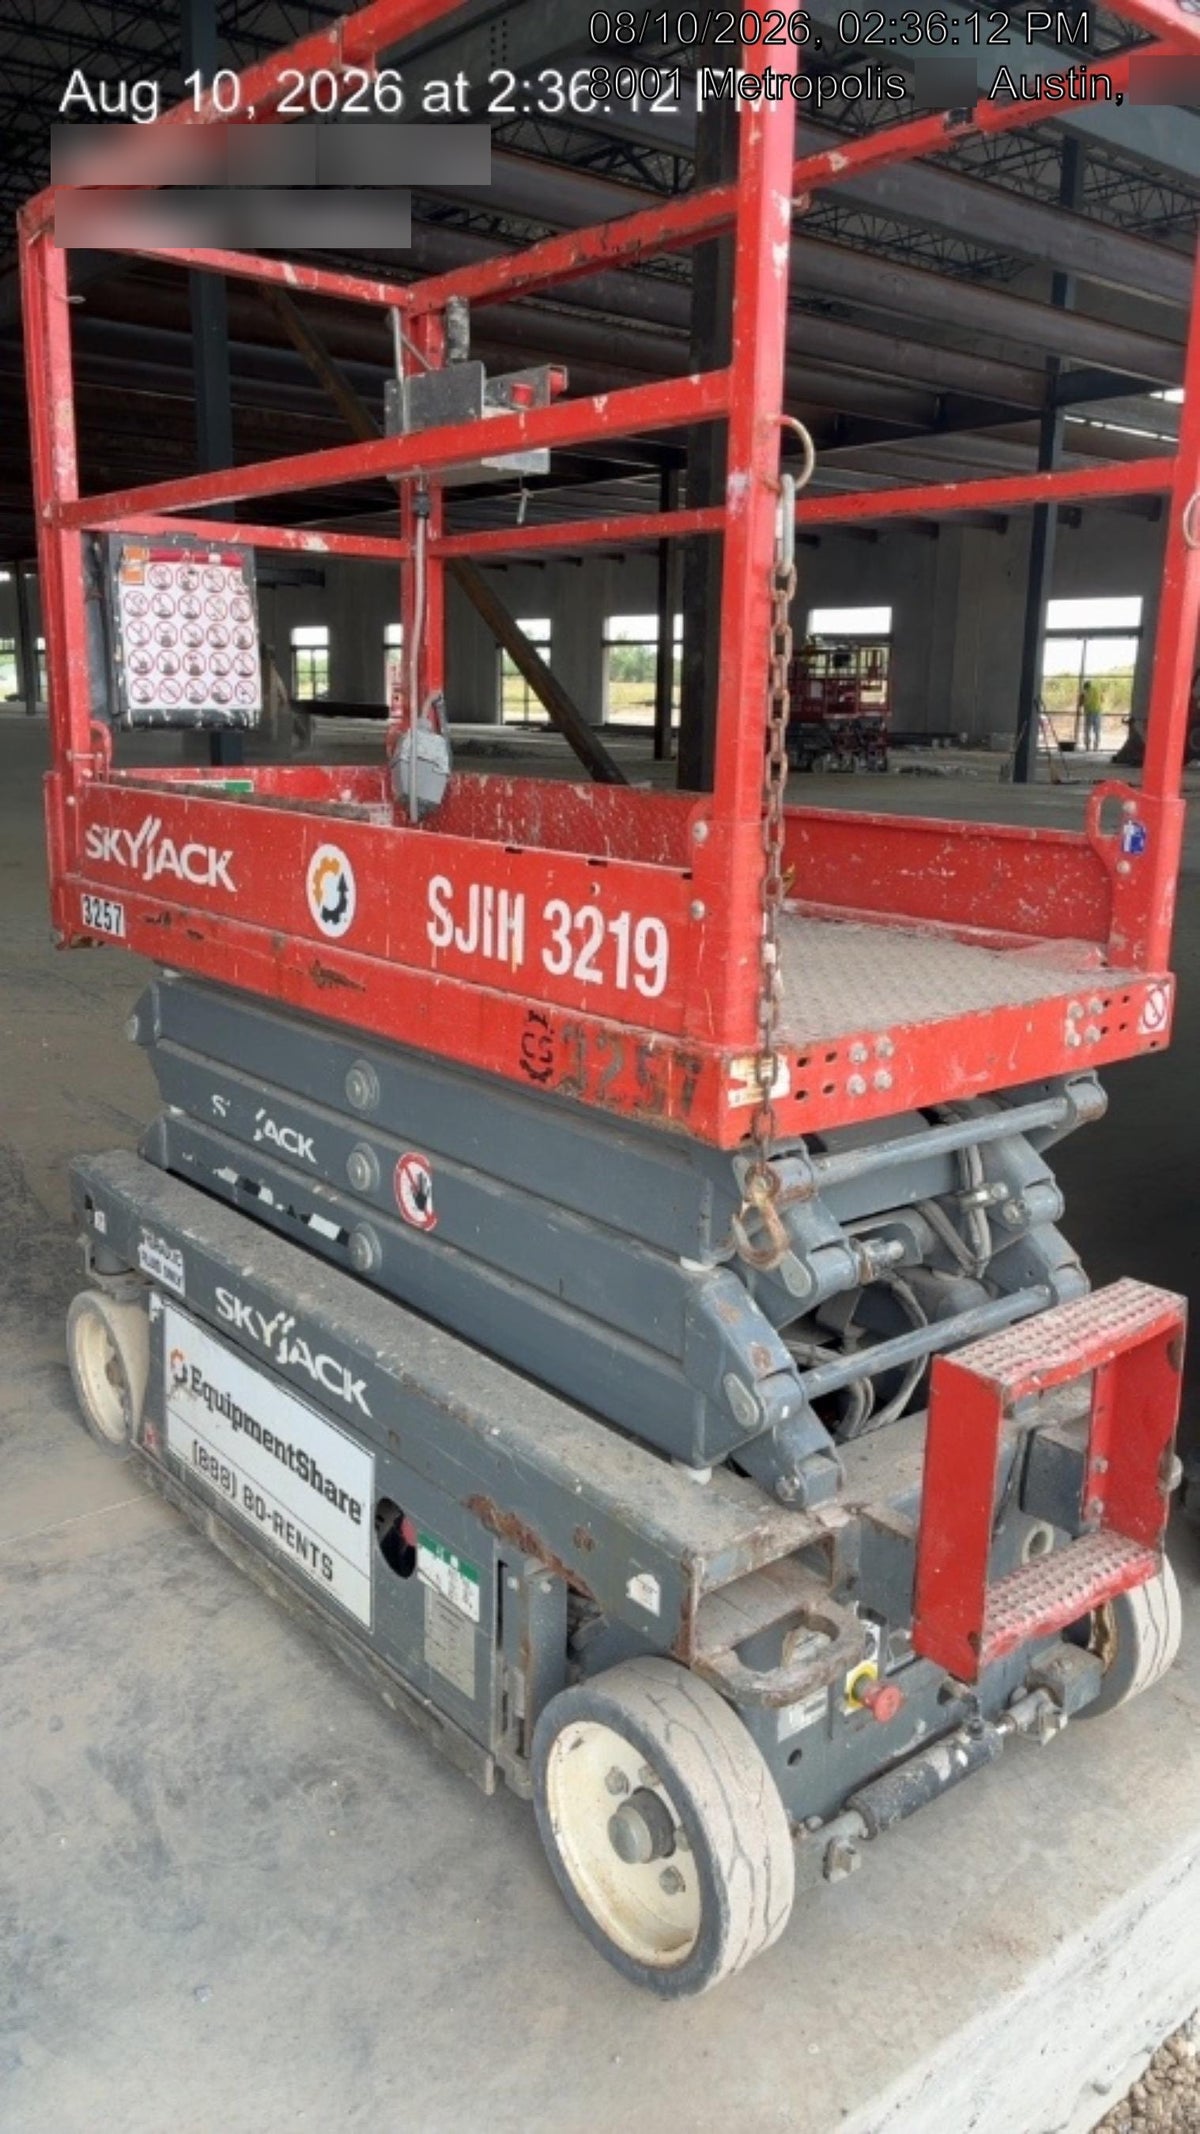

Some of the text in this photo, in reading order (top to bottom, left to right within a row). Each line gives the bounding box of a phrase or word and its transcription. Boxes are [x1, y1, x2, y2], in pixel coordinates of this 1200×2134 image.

[85, 815, 238, 892] SKYJACK
[84, 895, 121, 934] 3257
[541, 899, 669, 998] 3219
[215, 1286, 372, 1418] SKYJACK
[191, 1365, 362, 1525] EquipmentShare
[193, 1439, 237, 1498] (888)
